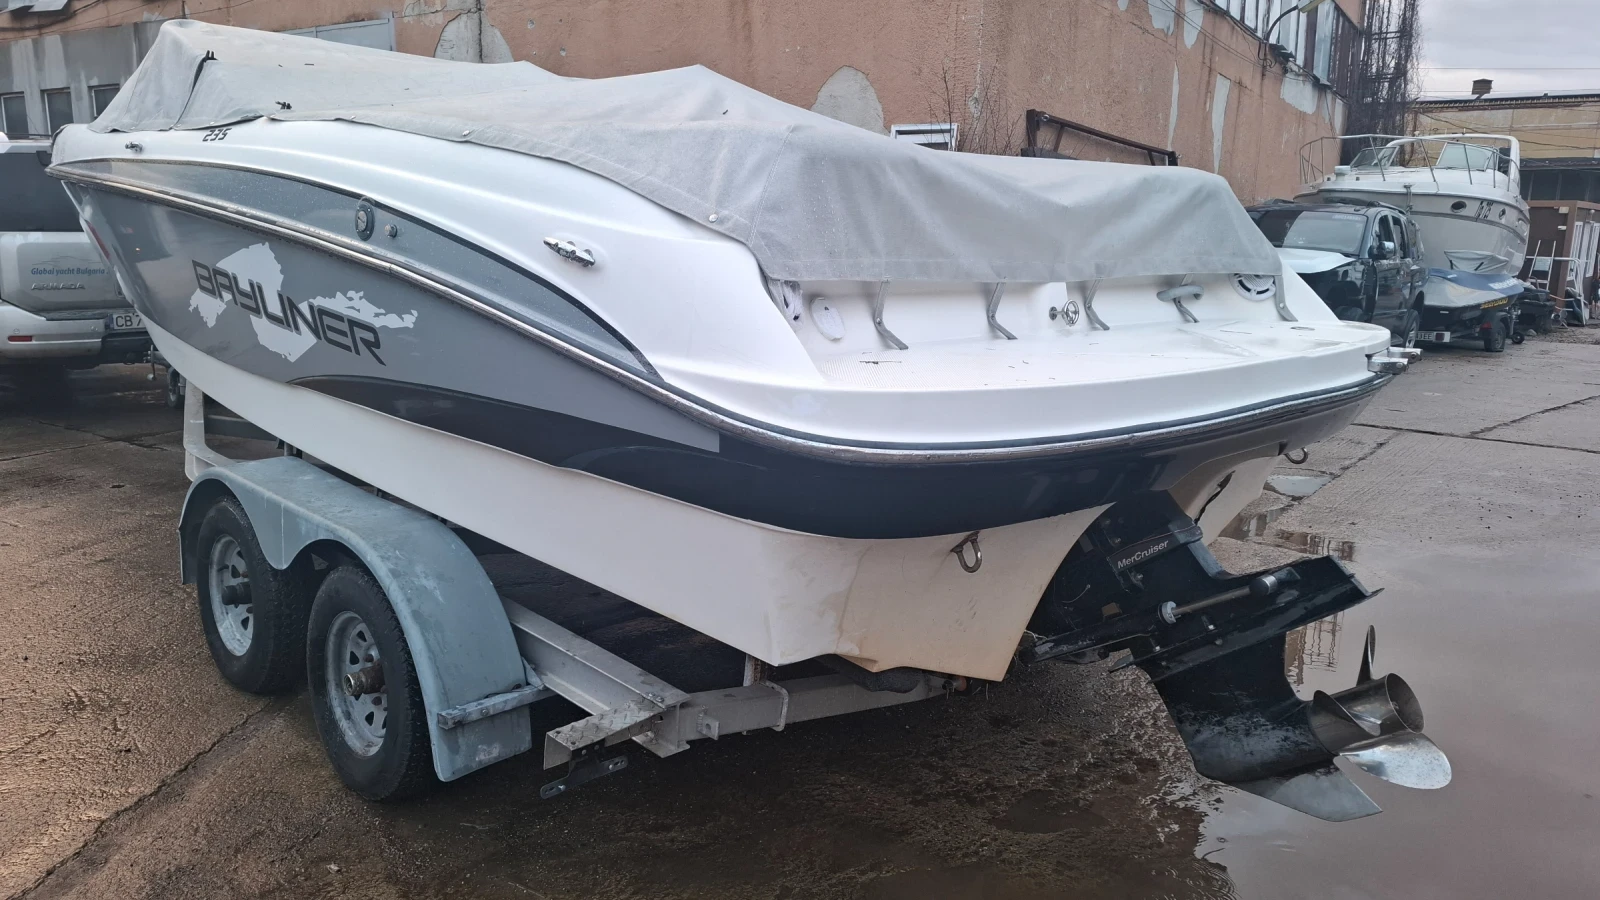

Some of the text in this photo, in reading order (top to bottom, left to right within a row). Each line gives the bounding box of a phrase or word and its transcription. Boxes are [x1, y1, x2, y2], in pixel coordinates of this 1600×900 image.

[202, 127, 233, 142] 235
[31, 267, 105, 277] Global yacht Bulgaria
[31, 282, 86, 291] ARMADA
[191, 259, 387, 367] BAYLINER
[1117, 540, 1169, 569] MerCruiser
